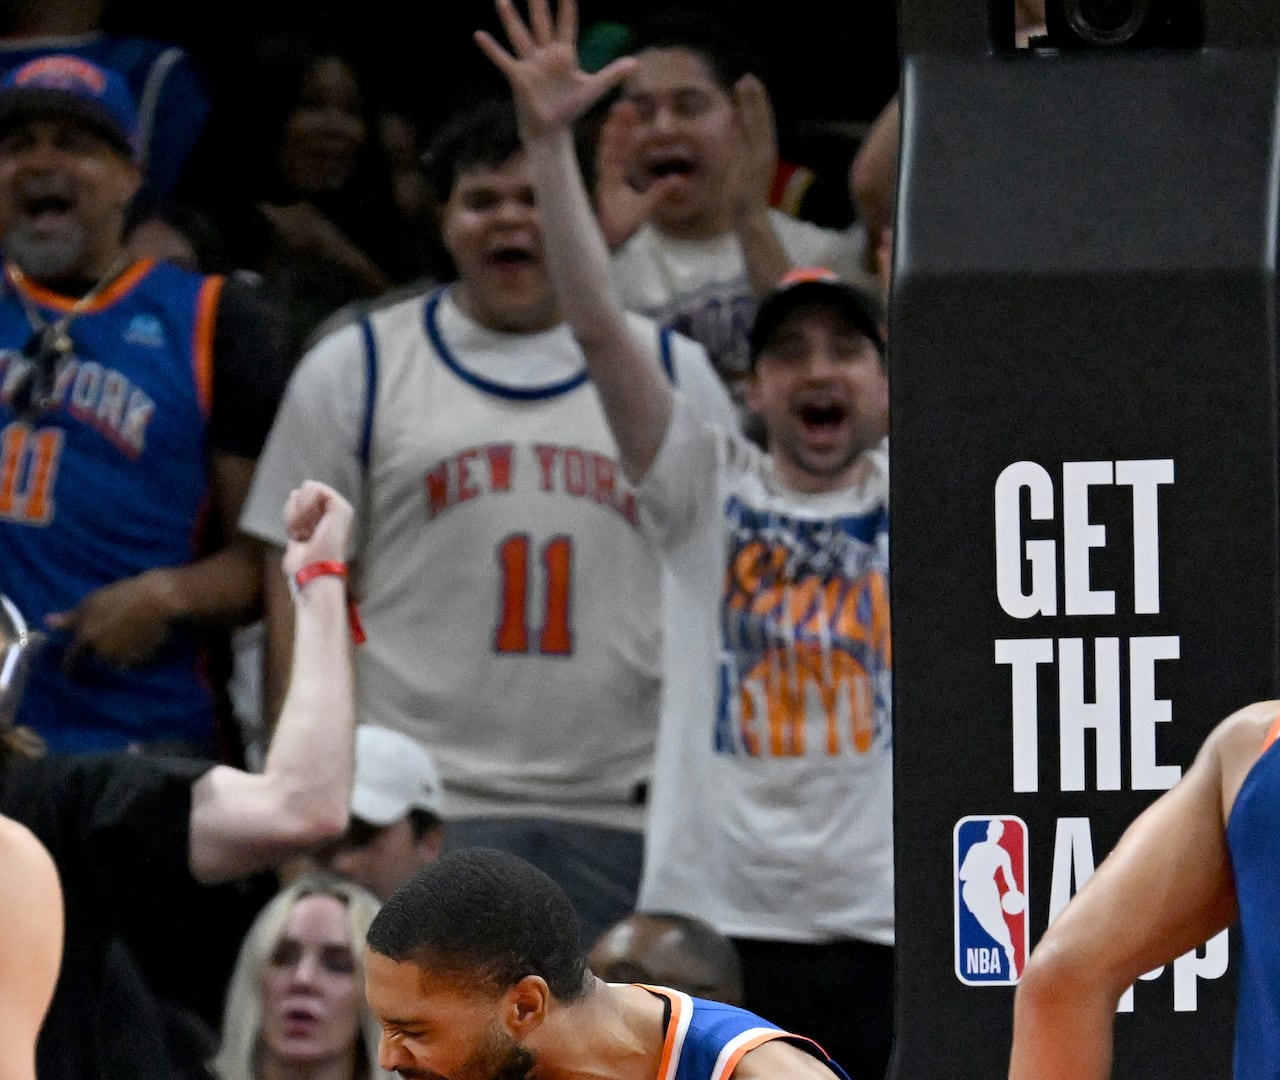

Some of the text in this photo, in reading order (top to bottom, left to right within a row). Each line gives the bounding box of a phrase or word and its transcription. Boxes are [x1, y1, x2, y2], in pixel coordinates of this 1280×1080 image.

[424, 441, 516, 521] NEW
[994, 458, 1176, 620] GET
[491, 531, 576, 657] 11
[994, 635, 1183, 794] THE
[966, 947, 1002, 975] NBA
